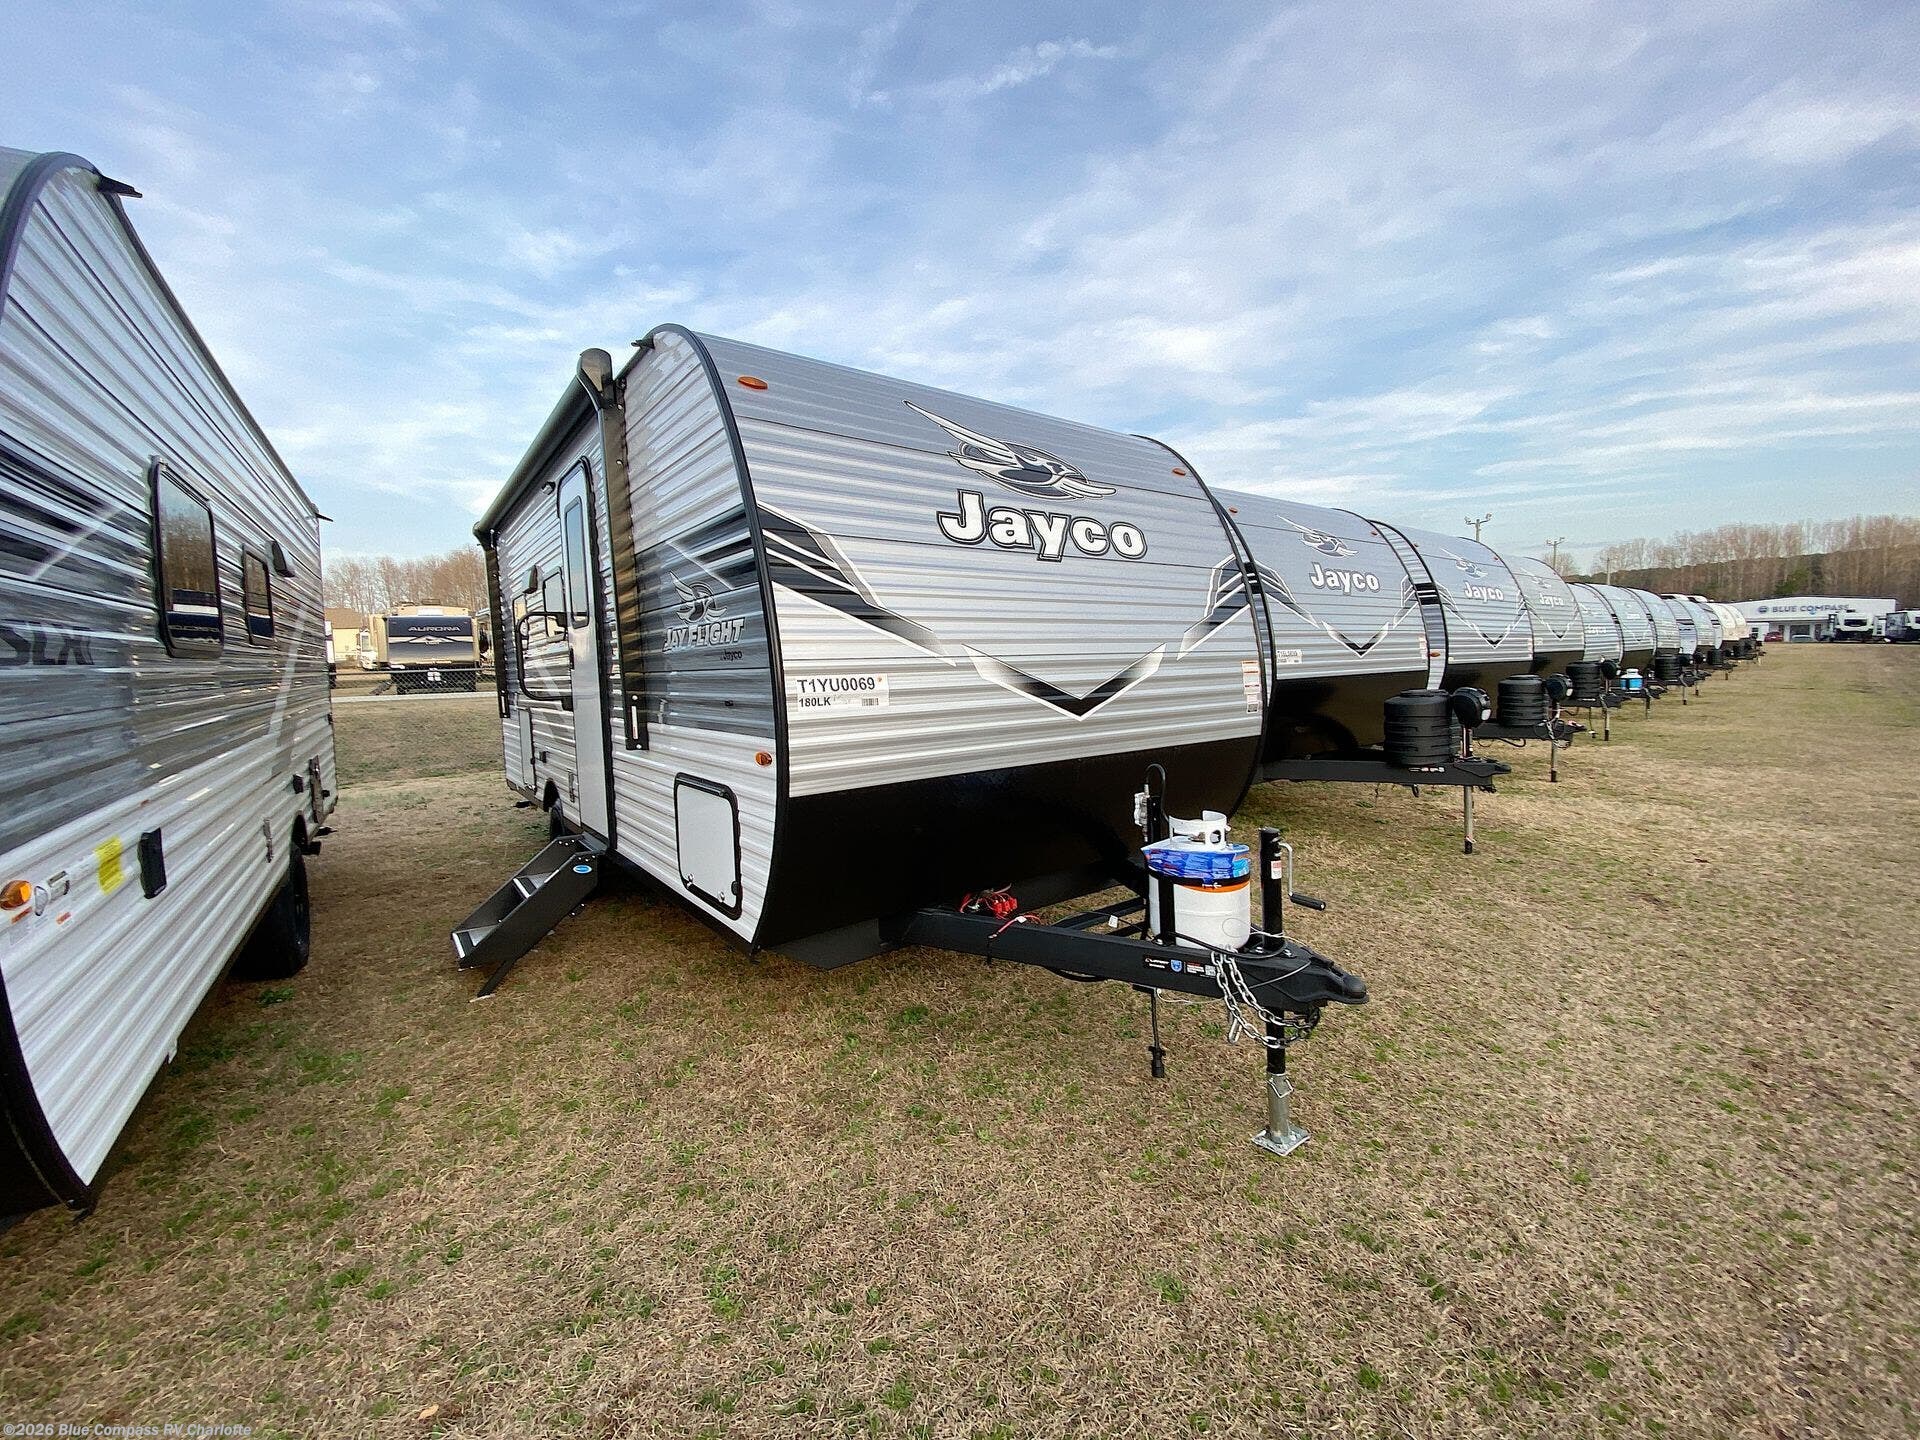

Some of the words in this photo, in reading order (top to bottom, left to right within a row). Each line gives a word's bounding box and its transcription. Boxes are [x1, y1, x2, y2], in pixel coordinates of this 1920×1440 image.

[936, 489, 1148, 562] Jayco
[1308, 561, 1381, 596] Jayco
[1463, 581, 1504, 604] Jayco
[1539, 593, 1565, 608] Jayco
[1800, 604, 1849, 612] COMPASS
[662, 627, 687, 652] JAY
[687, 617, 745, 648] FLIGHT
[797, 677, 876, 693] T1YU0069
[799, 697, 831, 707] 180LK
